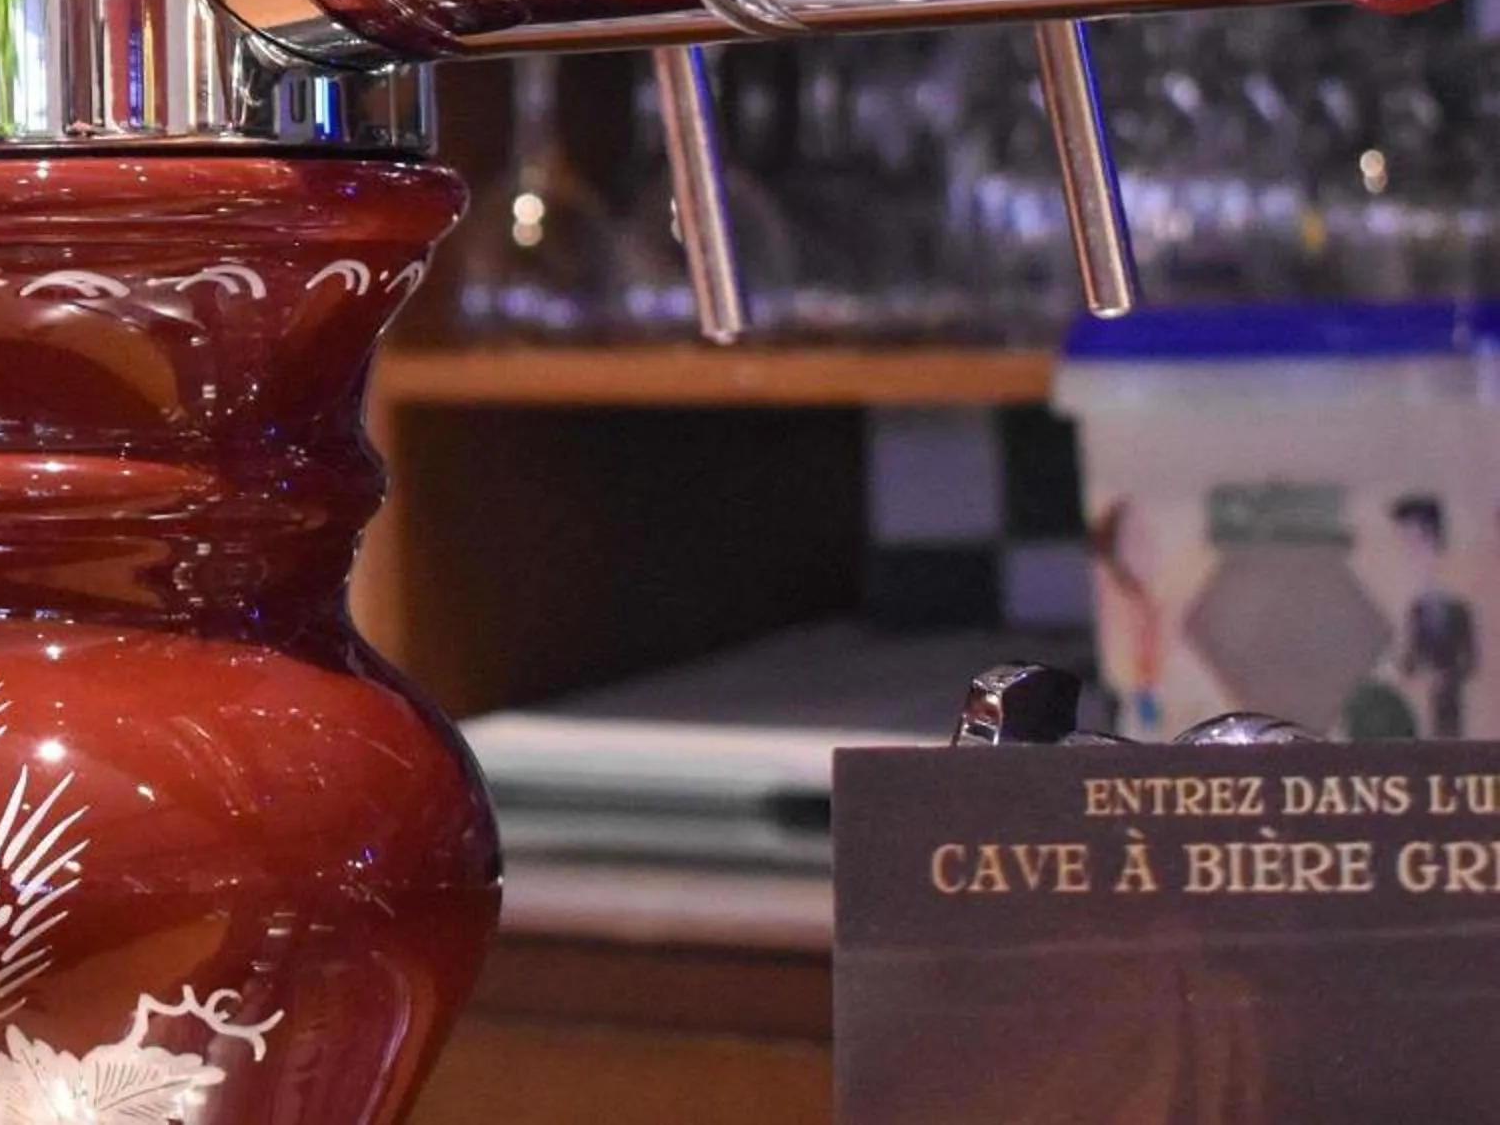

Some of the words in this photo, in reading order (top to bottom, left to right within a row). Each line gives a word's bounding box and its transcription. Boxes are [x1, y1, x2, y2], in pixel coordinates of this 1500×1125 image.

[1085, 777, 1265, 816] ENTREZ
[1282, 774, 1411, 816] DANS
[931, 842, 1091, 894] CAVE
[1113, 828, 1157, 892] À
[1183, 827, 1376, 893] BIÈRE
